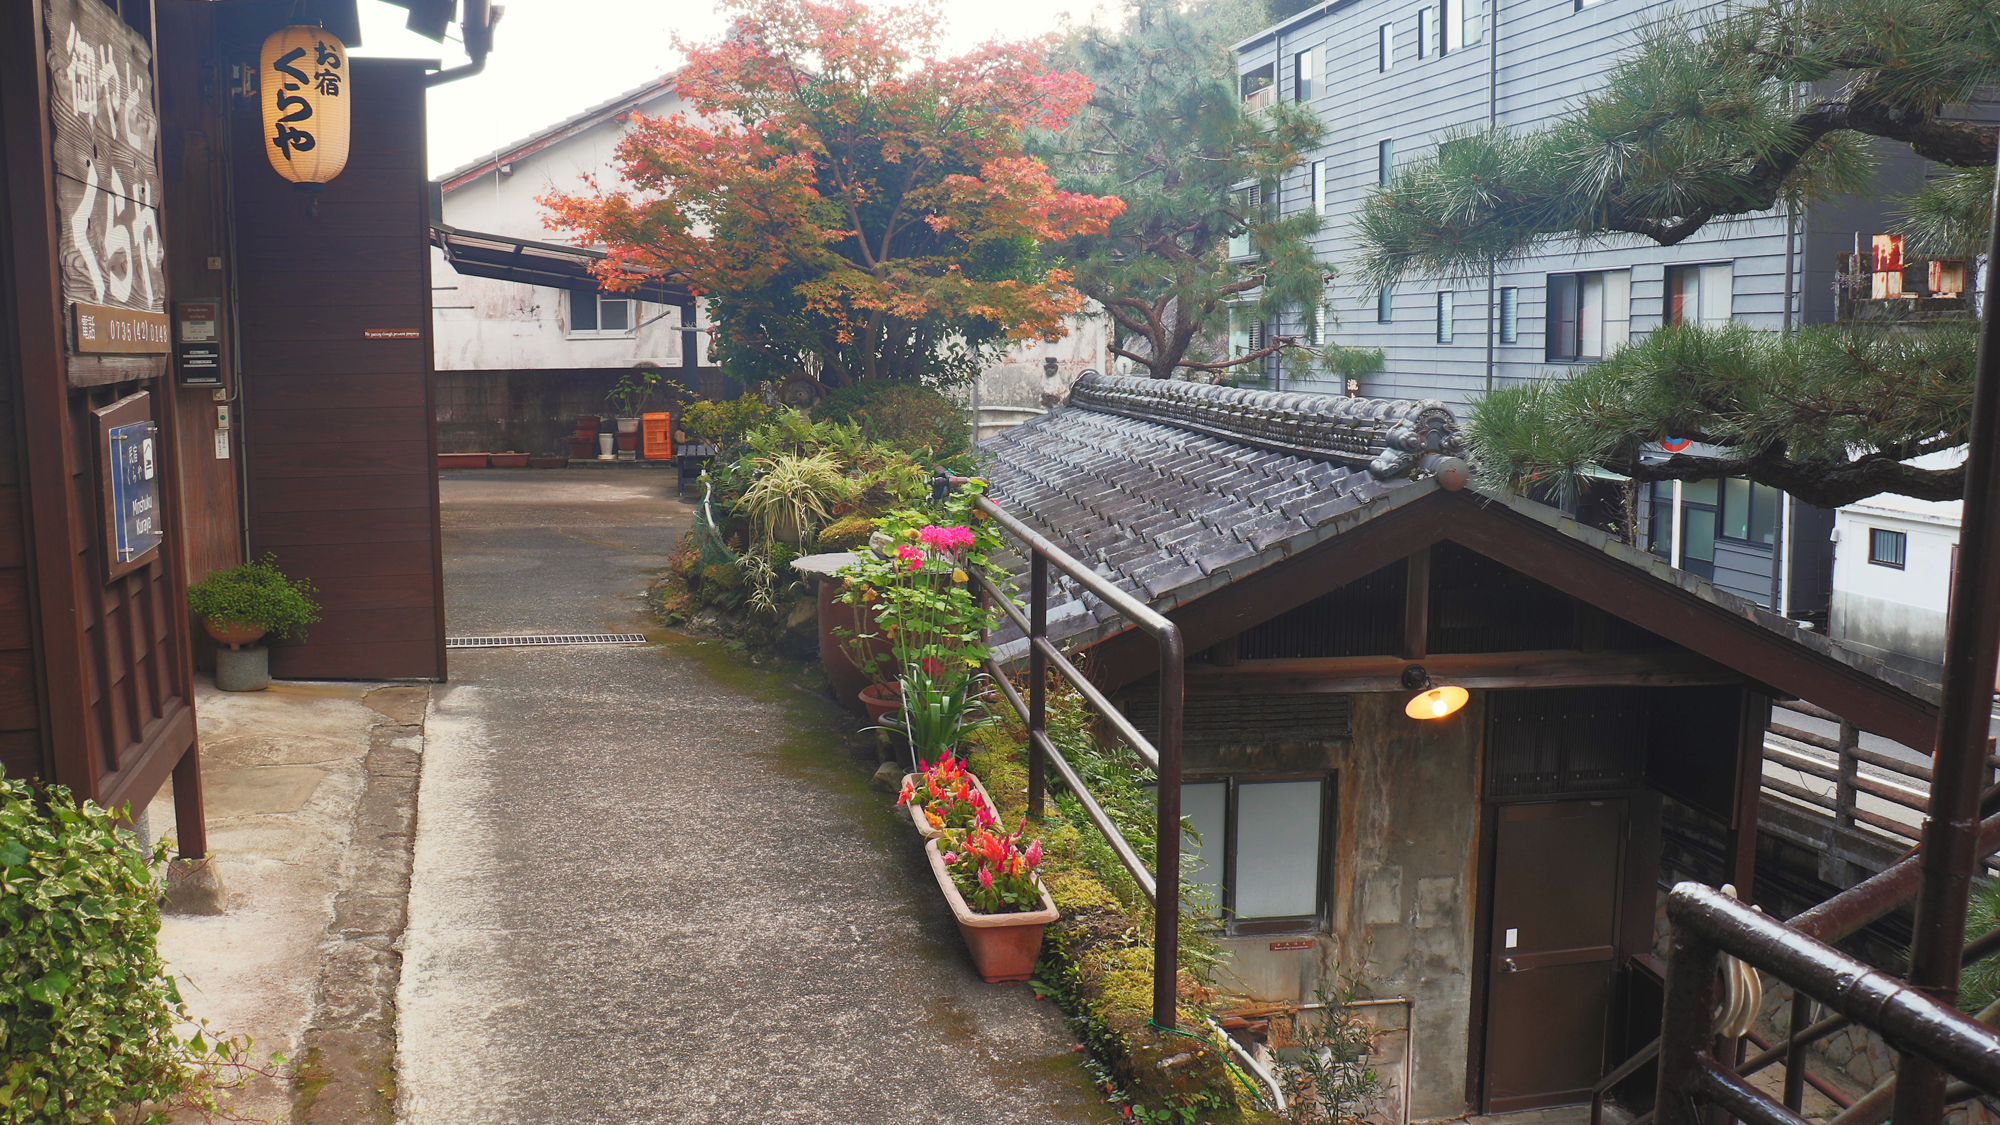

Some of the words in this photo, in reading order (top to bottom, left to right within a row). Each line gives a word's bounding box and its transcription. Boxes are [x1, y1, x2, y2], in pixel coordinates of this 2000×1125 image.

[314, 40, 342, 97] お宿
[272, 46, 316, 161] くらや
[71, 158, 159, 310] くらや
[126, 464, 143, 486] くらや
[132, 493, 153, 517] Minshuku
[136, 516, 152, 536] Kuraya
